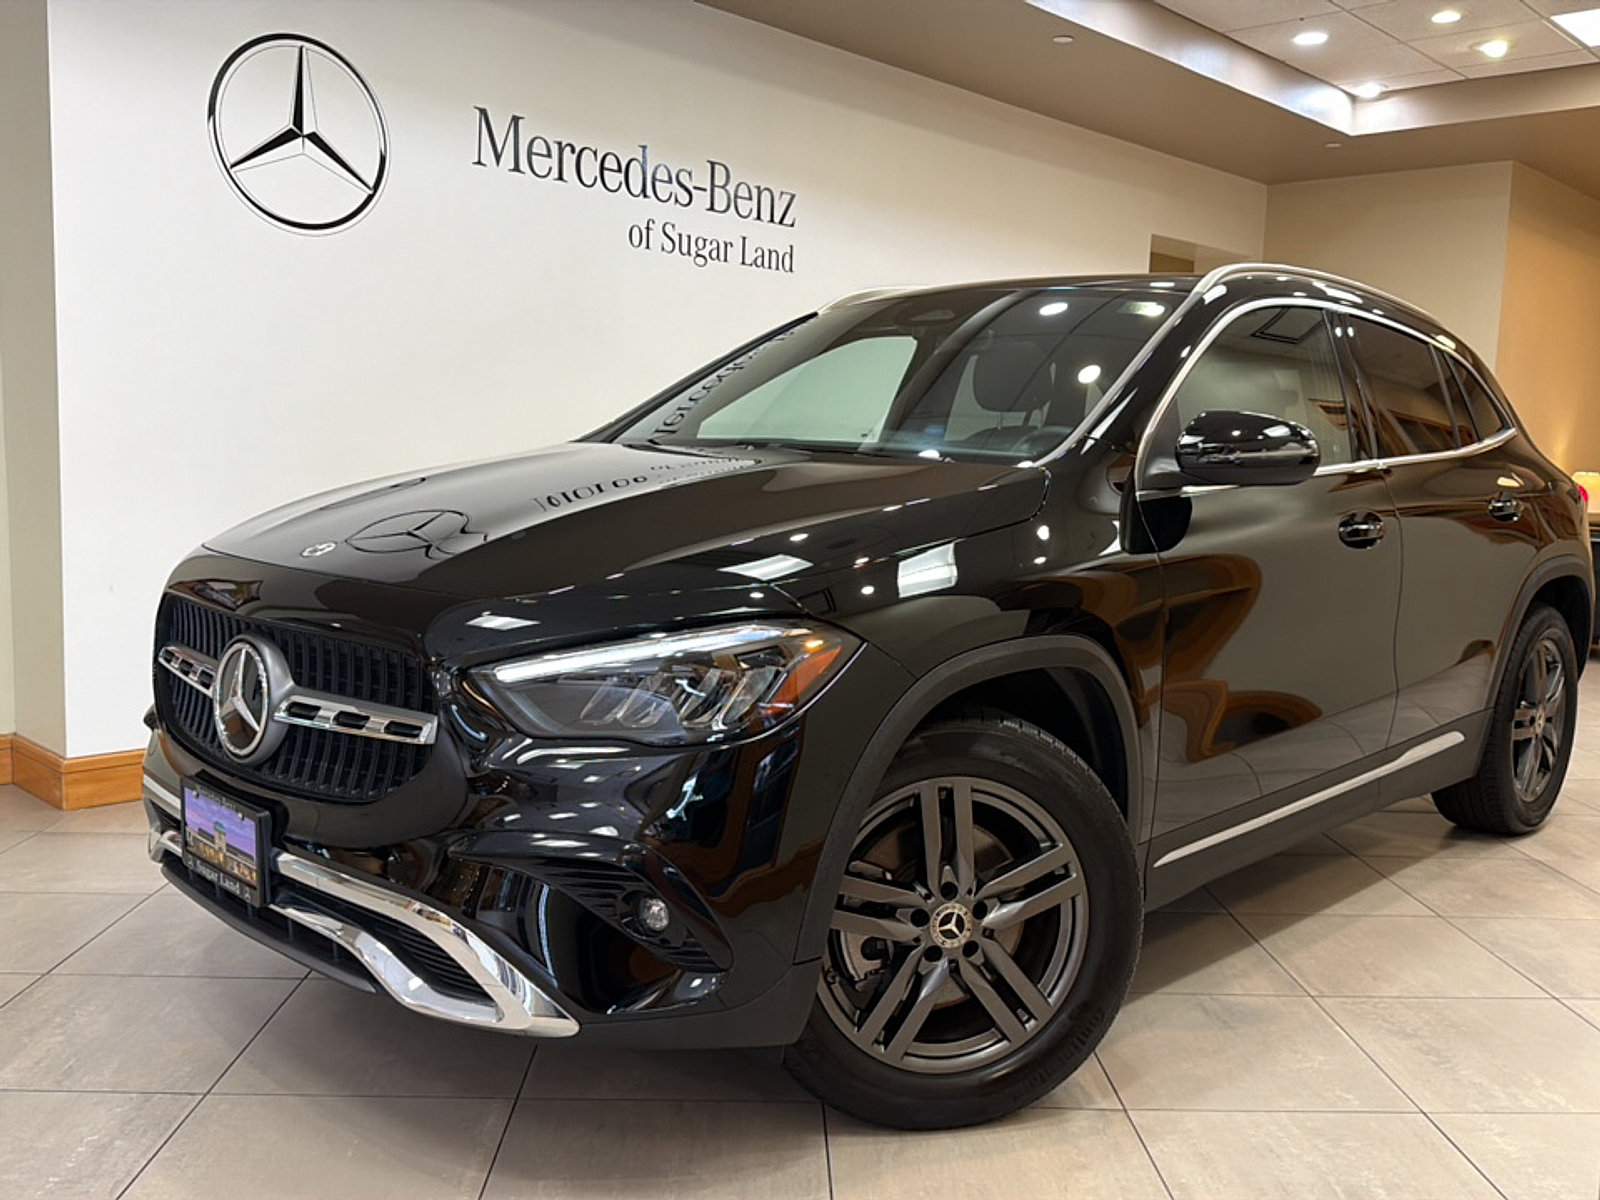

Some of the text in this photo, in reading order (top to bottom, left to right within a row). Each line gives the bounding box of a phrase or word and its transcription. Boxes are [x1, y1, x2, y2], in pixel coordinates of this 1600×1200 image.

[472, 105, 797, 228] Mercedes-Benz
[628, 218, 795, 274] of Sugar Land
